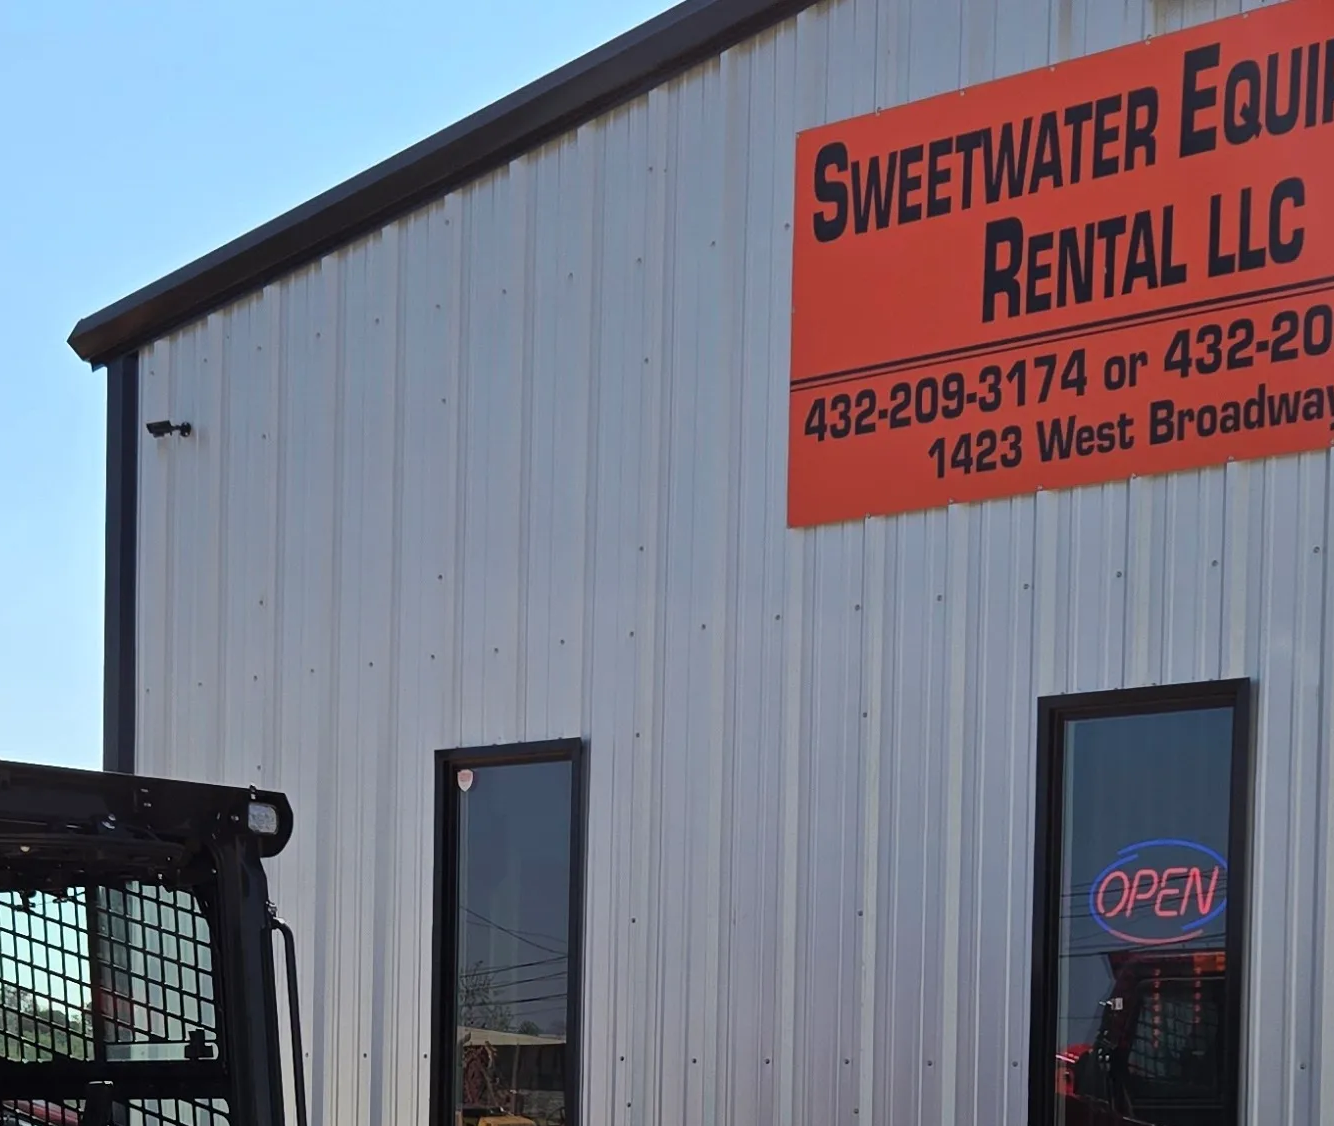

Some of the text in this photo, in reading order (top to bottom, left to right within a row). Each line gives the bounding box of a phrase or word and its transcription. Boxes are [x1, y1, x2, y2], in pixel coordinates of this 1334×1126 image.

[813, 86, 1159, 243] SWEETWATER
[982, 177, 1305, 323] RENTAL LLC
[804, 349, 1087, 442] 432-209-3174
[1104, 351, 1148, 391] or
[928, 425, 1022, 479] 1423
[1036, 413, 1134, 462] West
[1097, 866, 1219, 917] OPEN
